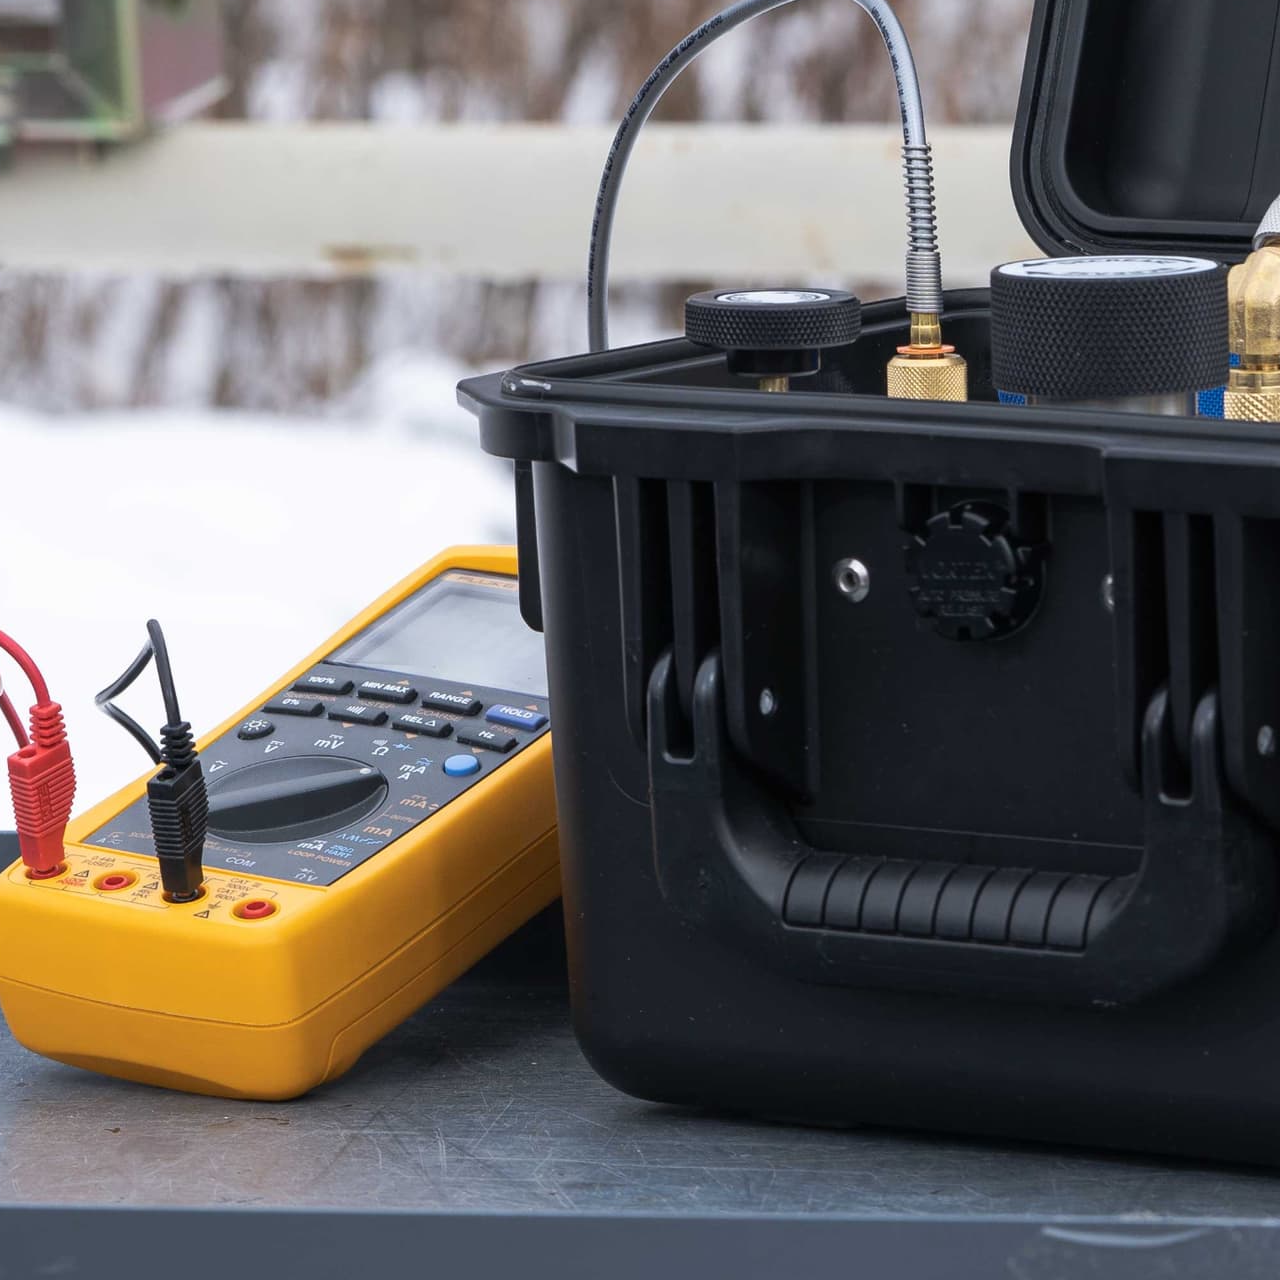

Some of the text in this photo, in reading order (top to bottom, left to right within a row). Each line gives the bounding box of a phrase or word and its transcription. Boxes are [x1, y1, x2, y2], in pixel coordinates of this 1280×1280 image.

[308, 675, 336, 685] 100%
[361, 680, 411, 694] MIN MAX
[282, 698, 300, 706] 0%
[429, 691, 473, 705] RANGE
[500, 705, 533, 719] HOLD
[400, 714, 423, 724] REL
[314, 739, 345, 750] mV
[399, 764, 427, 775] mA
[400, 798, 427, 809] mA
[363, 826, 393, 838] mA
[297, 841, 324, 851] mA
[287, 849, 352, 867] LOOP POWER
[324, 848, 353, 859] HART
[225, 856, 257, 868] COM
